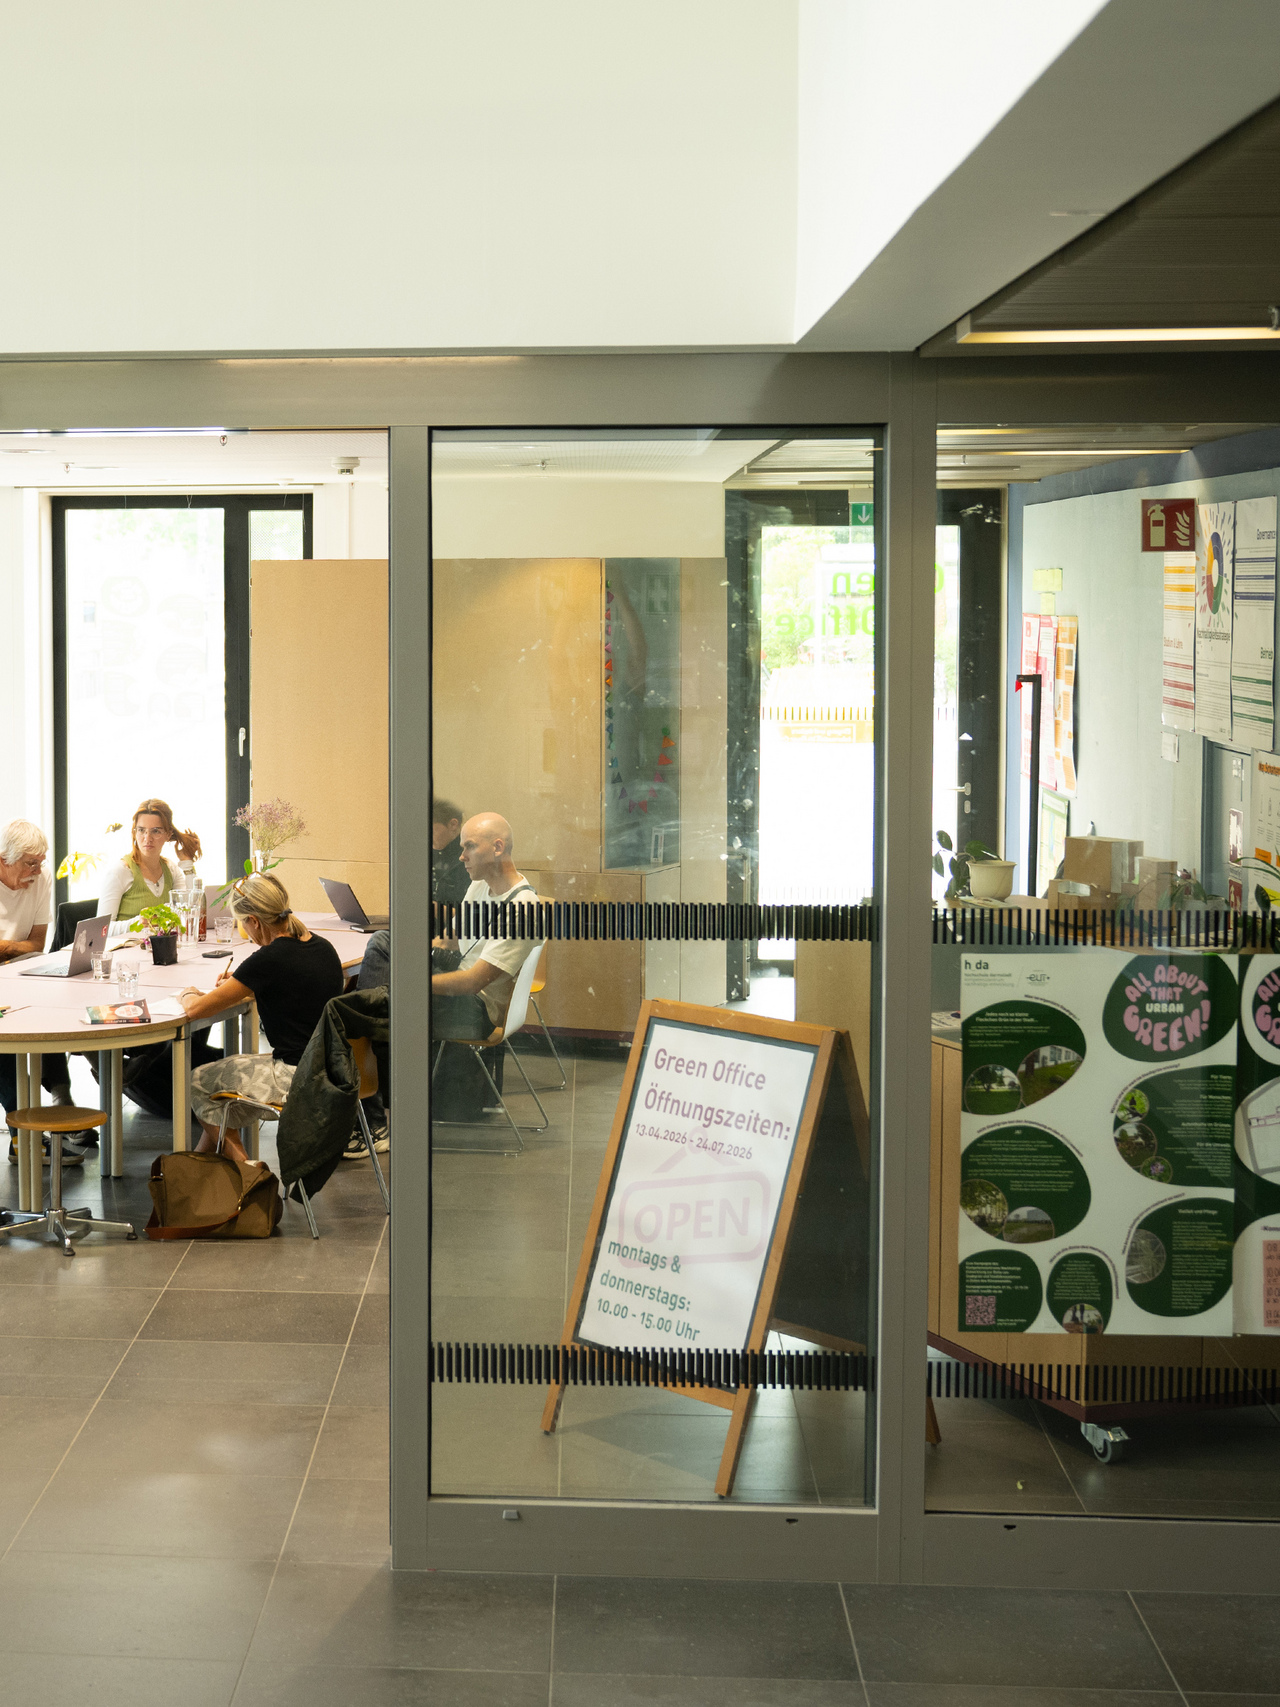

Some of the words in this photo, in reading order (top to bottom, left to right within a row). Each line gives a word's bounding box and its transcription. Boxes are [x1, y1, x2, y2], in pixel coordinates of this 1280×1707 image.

[1125, 972, 1152, 1002] ALL
[1149, 987, 1183, 1001] THAT
[1154, 964, 1209, 996] ABOUT
[1123, 999, 1211, 1052] GREEN!
[1145, 1003, 1184, 1013] URBAN
[654, 1048, 708, 1080] Green
[712, 1059, 766, 1091] Office
[644, 1082, 791, 1140] Öffnungszeiten:
[635, 1123, 687, 1145] 13.04.2026
[696, 1137, 753, 1161] 24.07.2026
[634, 1197, 750, 1244] OPEN
[607, 1240, 668, 1271] montags
[670, 1255, 681, 1273] &
[600, 1269, 691, 1312] donnerstags:
[597, 1298, 628, 1319] 10.00
[641, 1311, 672, 1333] 15.00
[675, 1320, 700, 1342] Uhr
